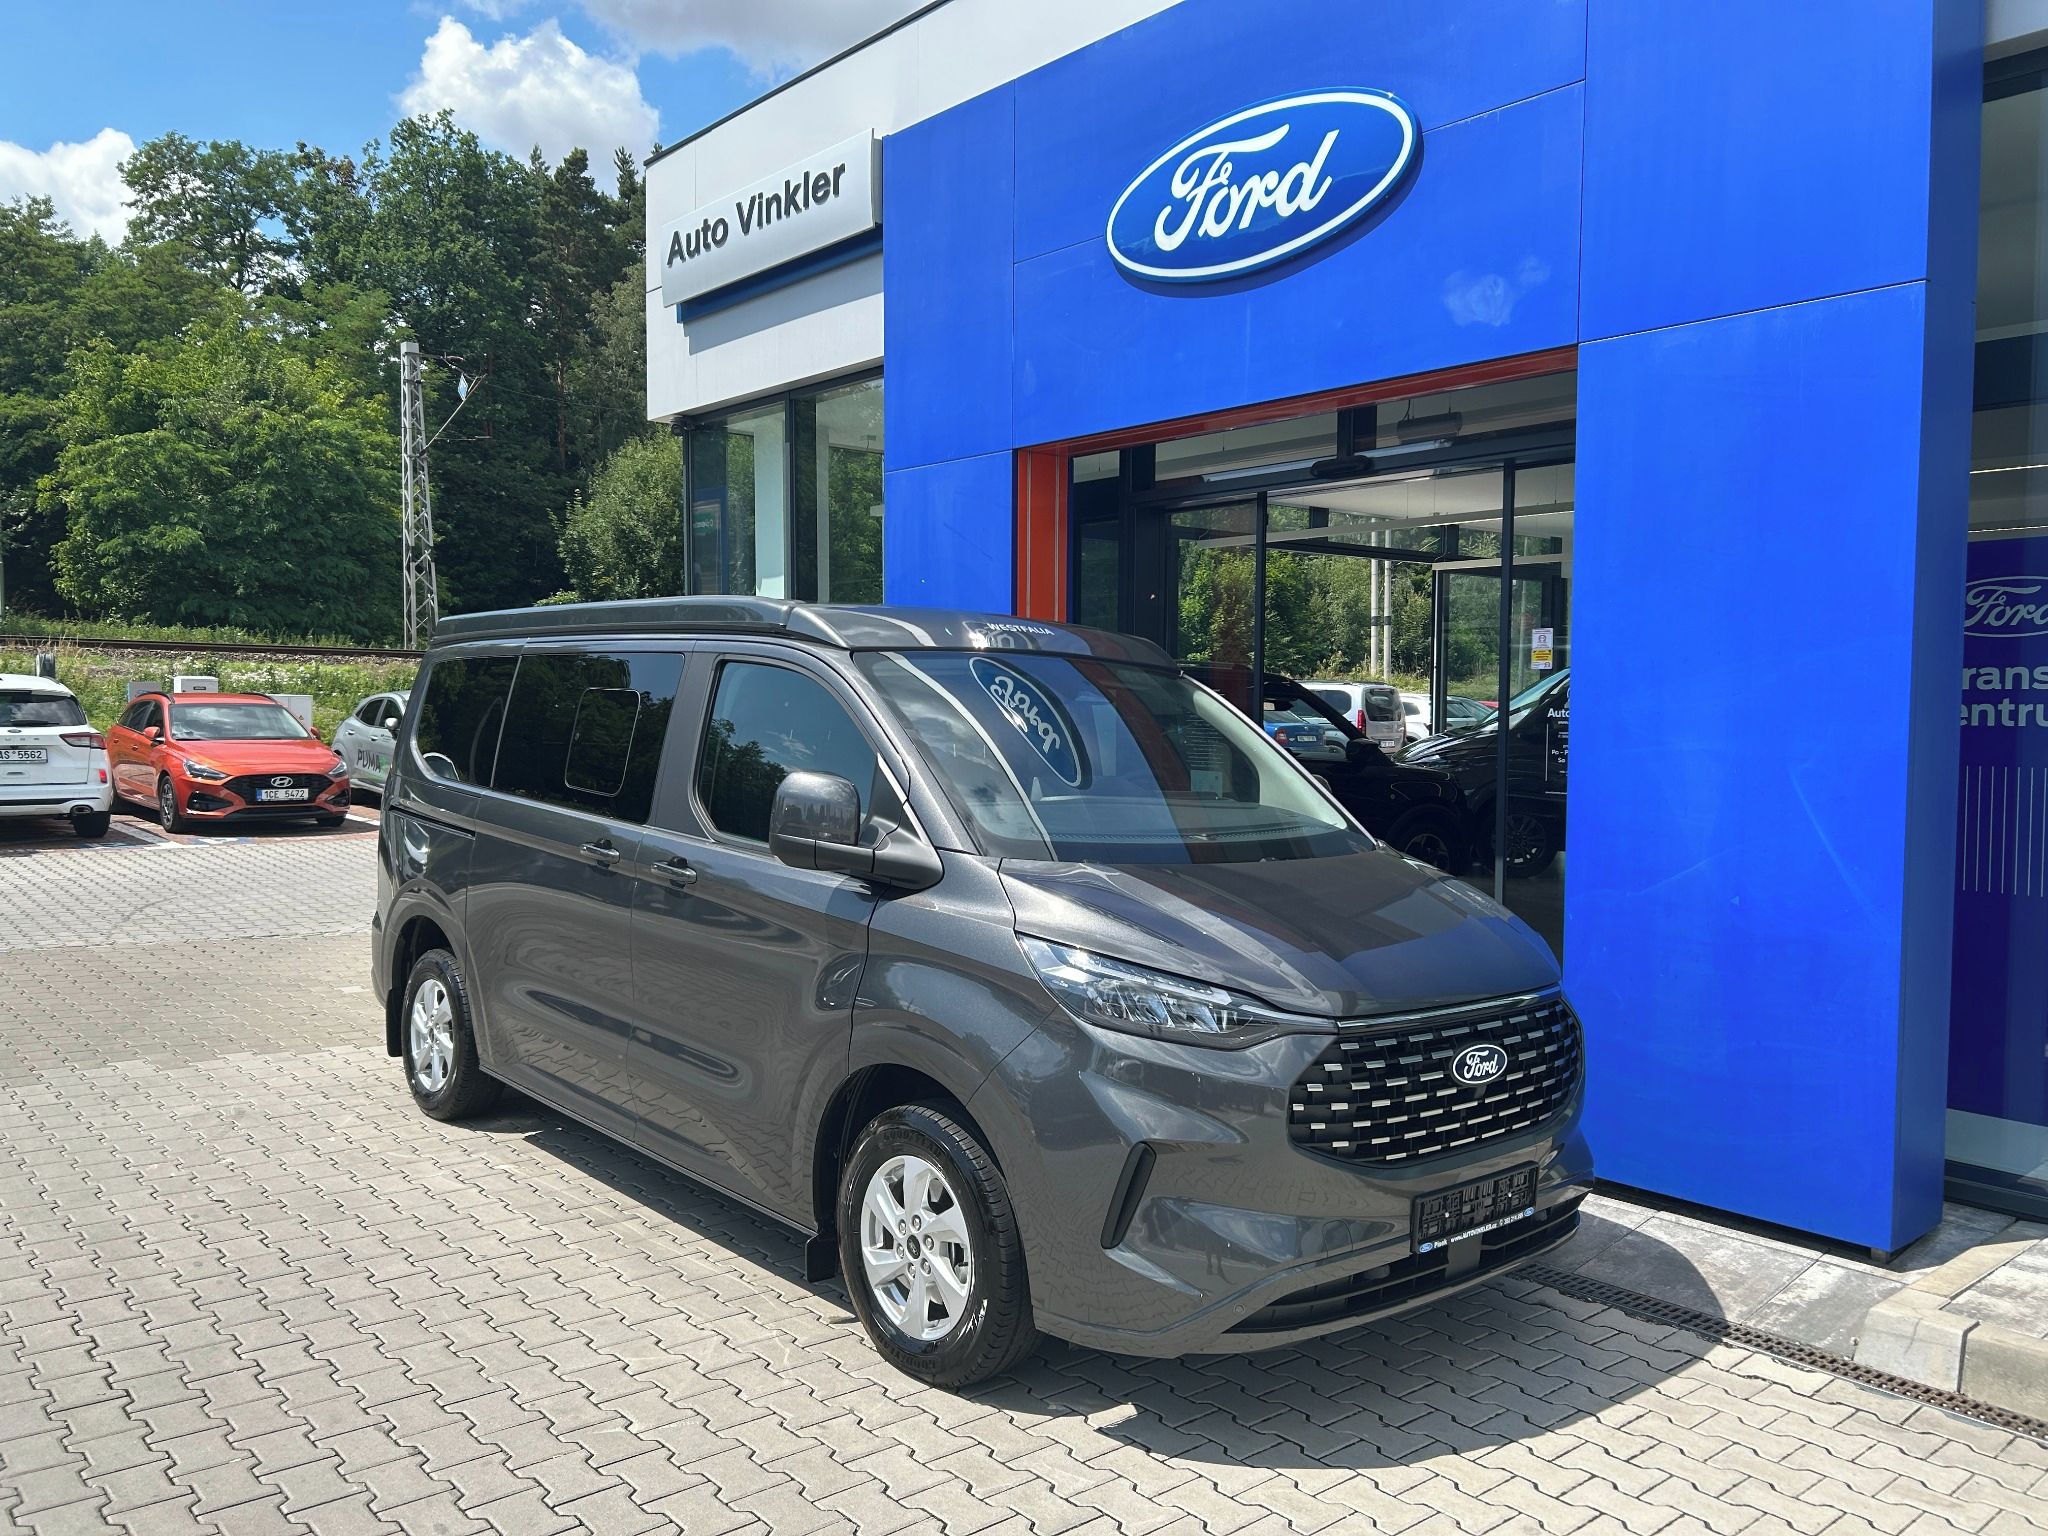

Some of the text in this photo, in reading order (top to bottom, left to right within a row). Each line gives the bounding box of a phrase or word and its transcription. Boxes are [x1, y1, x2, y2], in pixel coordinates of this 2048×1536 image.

[1154, 123, 1340, 251] Ford
[667, 163, 846, 268] Auto Vinkler
[986, 622, 1056, 636] WESTFALIA
[1547, 707, 1570, 718] Auto
[17, 750, 42, 759] 5562
[356, 748, 381, 773] PUMA
[264, 790, 305, 799] 1CE 5472
[1463, 1050, 1499, 1079] Ford
